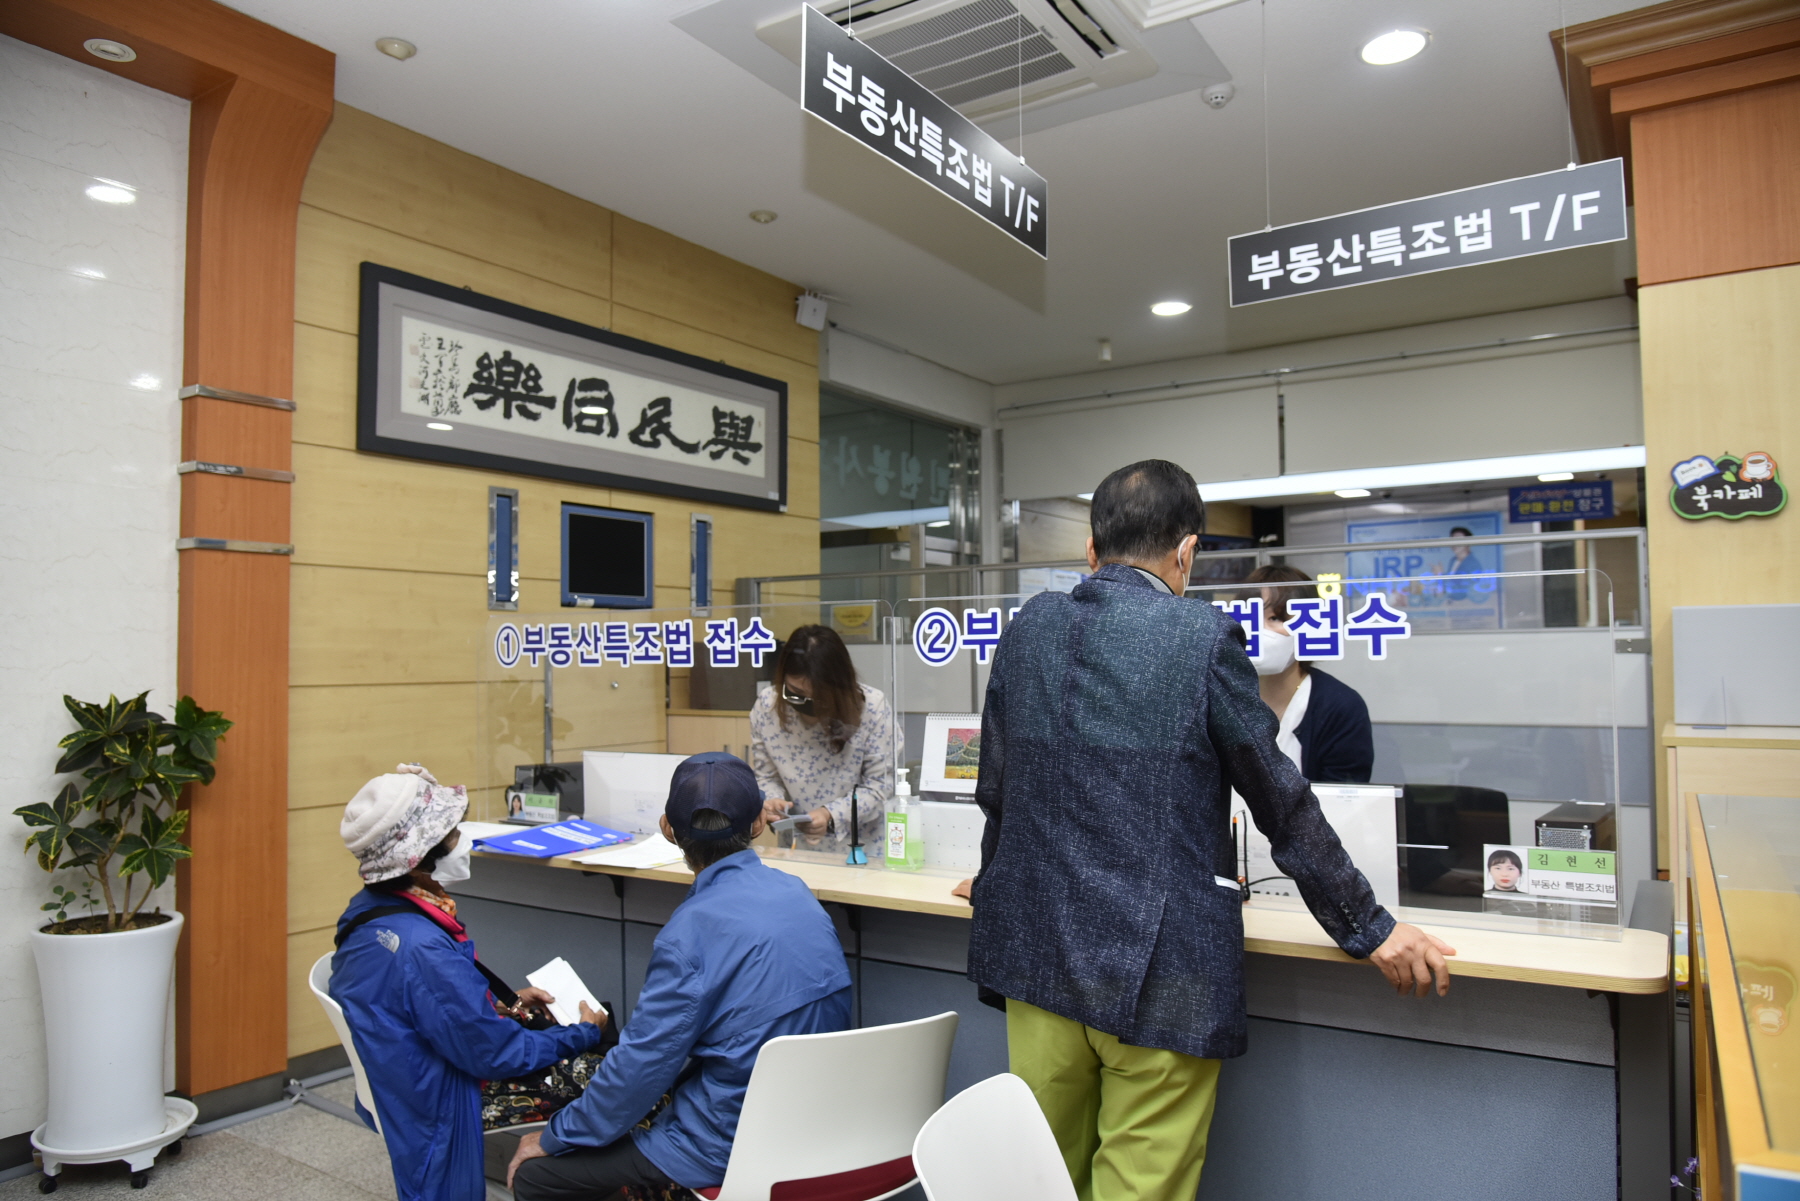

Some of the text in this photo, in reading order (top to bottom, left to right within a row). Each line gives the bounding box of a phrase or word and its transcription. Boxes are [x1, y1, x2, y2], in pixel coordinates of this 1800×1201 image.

[822, 51, 1040, 232] 부동산특조법 T/F
[1246, 190, 1601, 291] 부동산특조법 T/F
[1691, 484, 1763, 511] 북카페
[1374, 555, 1424, 579] IRP
[705, 618, 776, 667] 접수
[1285, 595, 1409, 659] 접수
[1537, 853, 1606, 869] 김 현 선
[1530, 878, 1615, 894] 부동산 특별조치법
